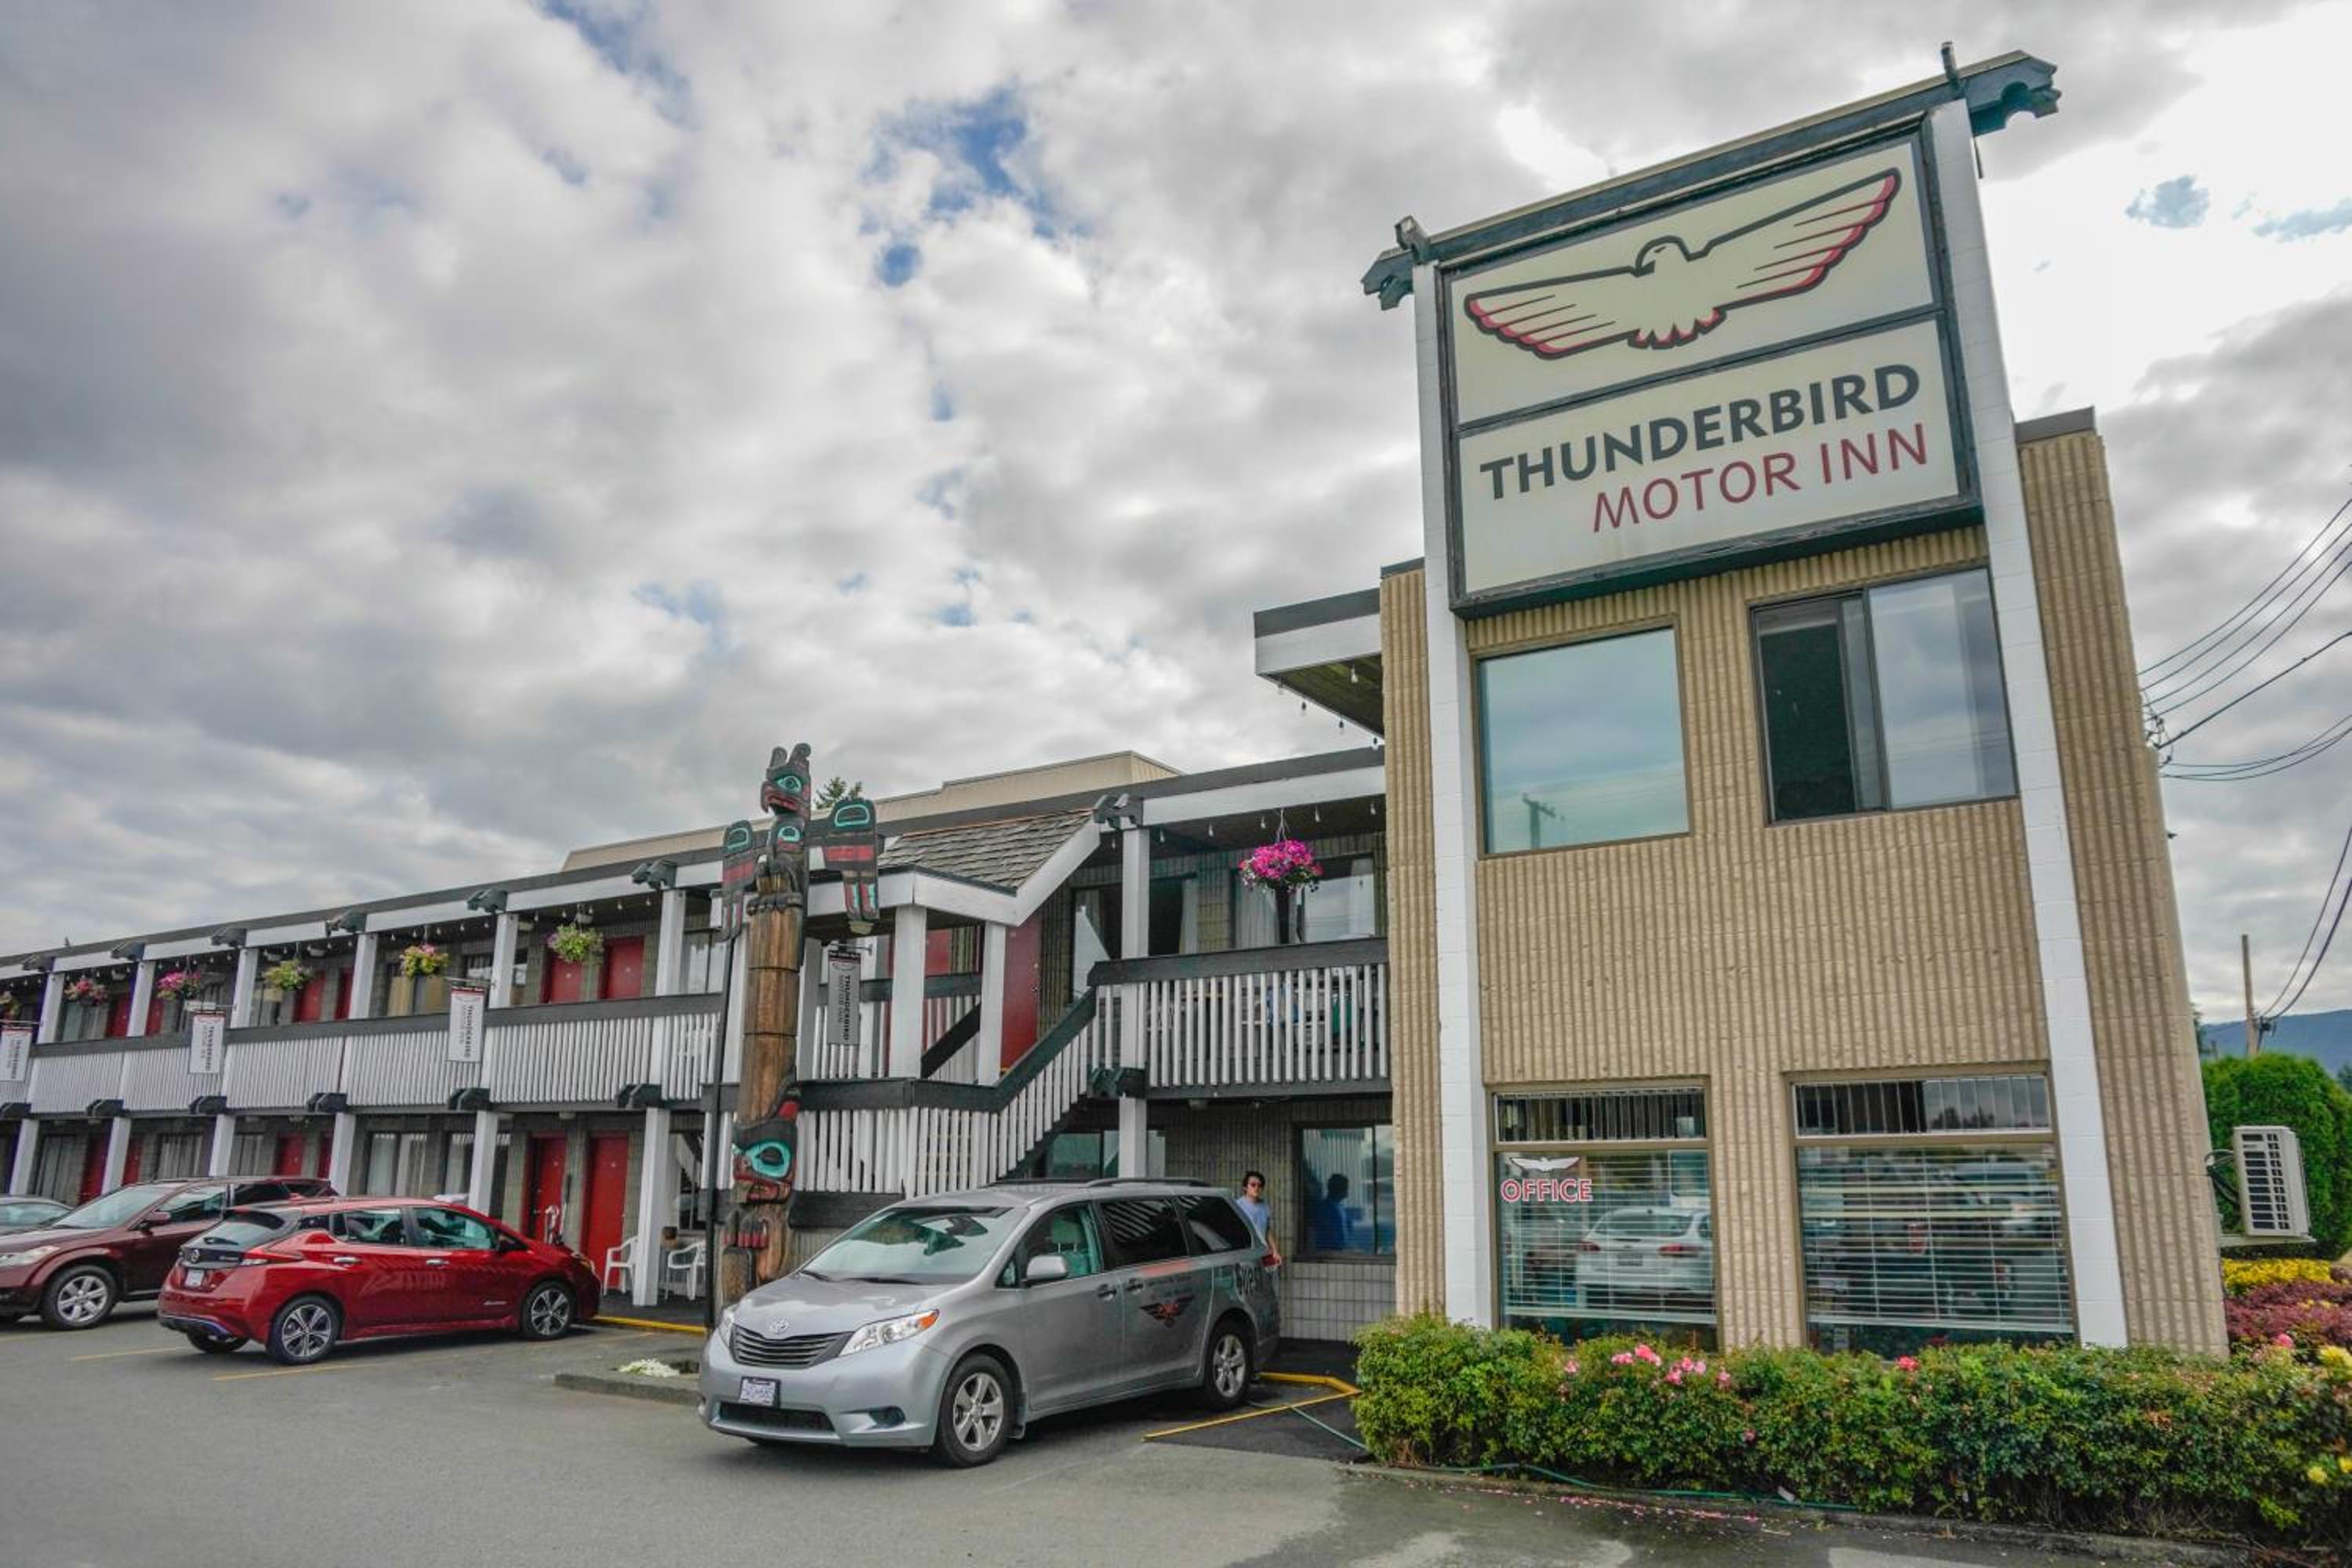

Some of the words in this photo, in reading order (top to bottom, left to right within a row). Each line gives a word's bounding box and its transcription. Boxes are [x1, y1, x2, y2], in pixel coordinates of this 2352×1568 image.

[1480, 364, 1920, 500] THUNDERBIRD
[1592, 451, 1802, 533] MOTOR
[1820, 423, 1928, 485] INN
[1500, 1178, 1593, 1203] OFFICE
